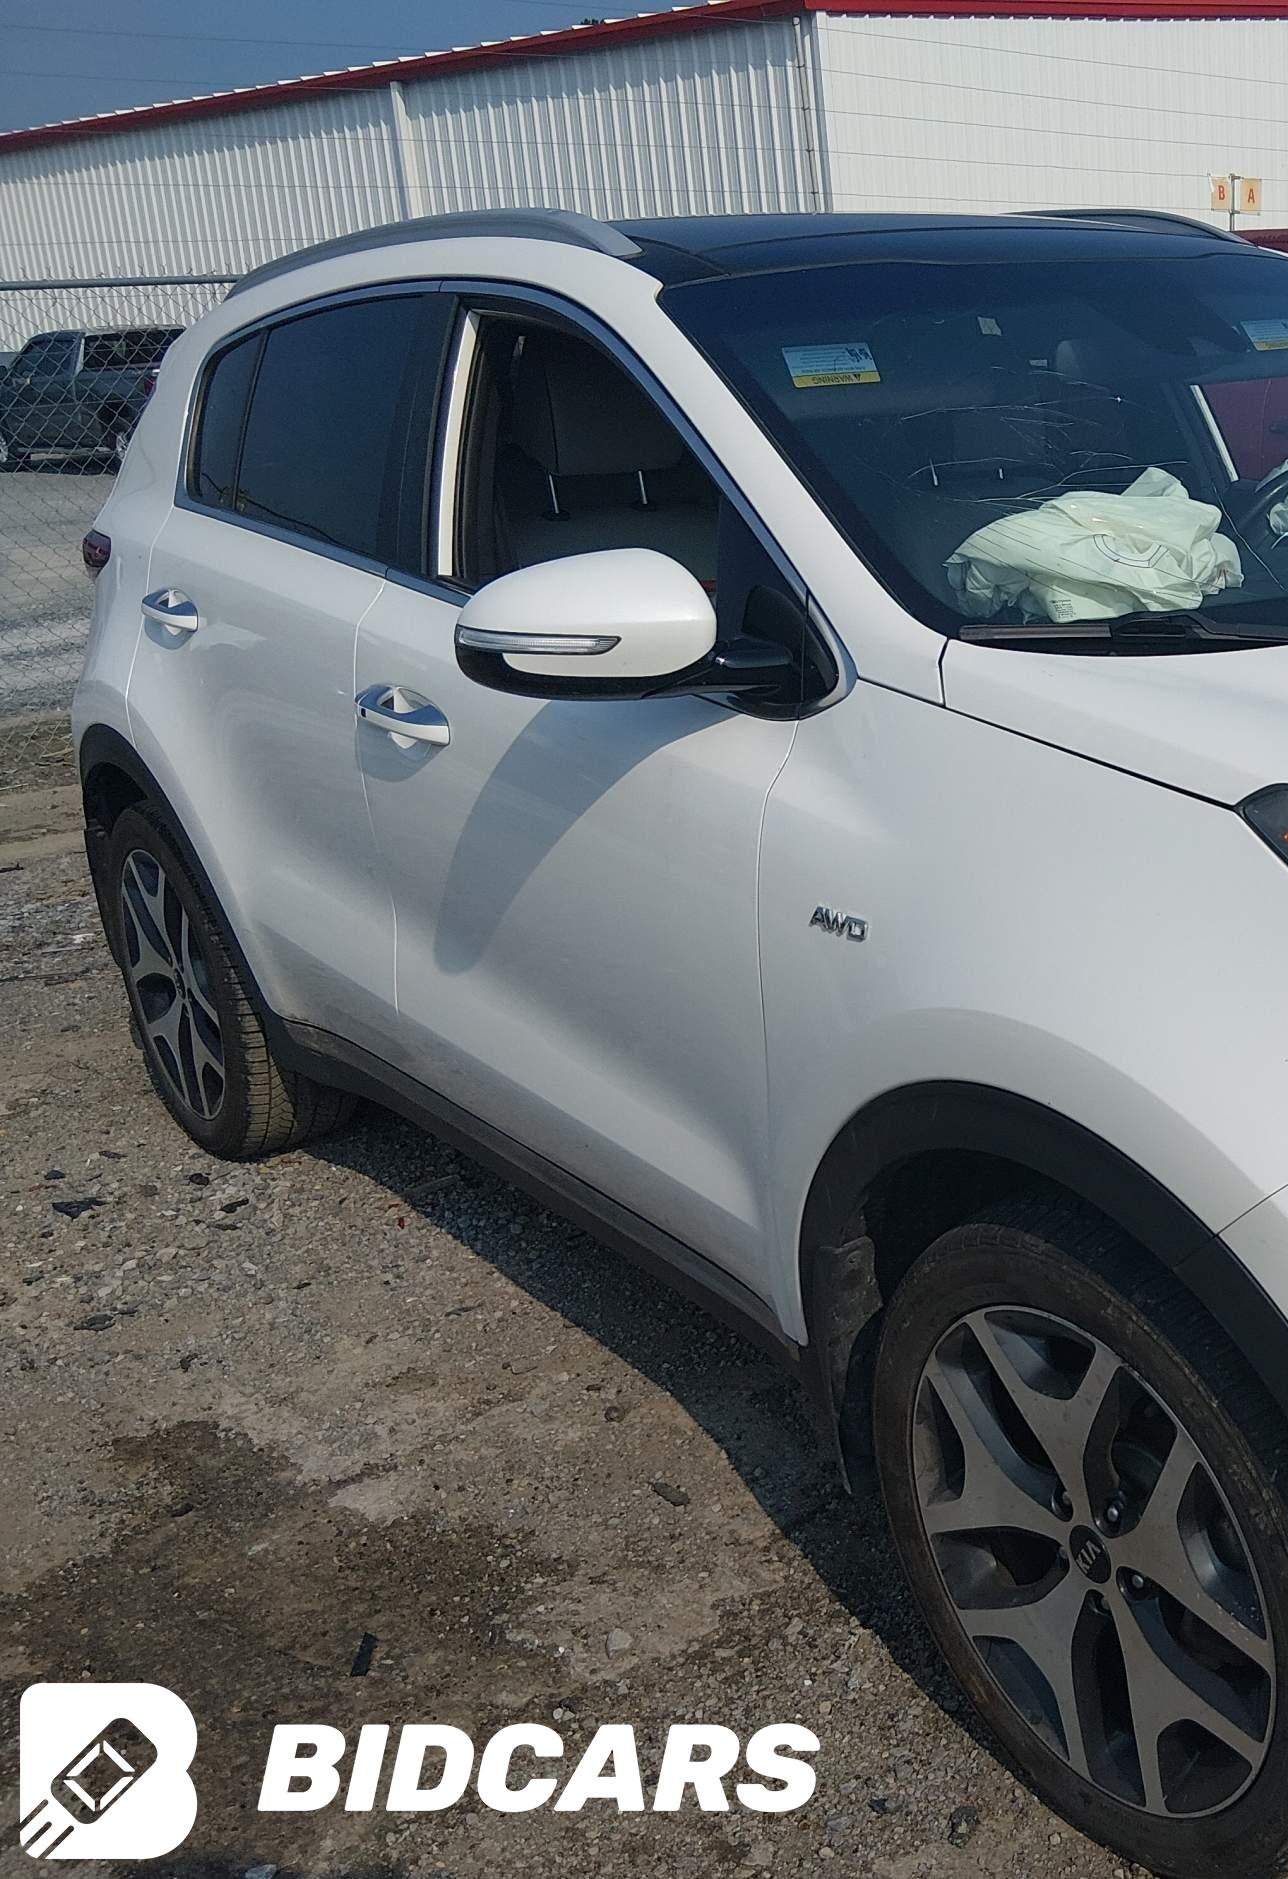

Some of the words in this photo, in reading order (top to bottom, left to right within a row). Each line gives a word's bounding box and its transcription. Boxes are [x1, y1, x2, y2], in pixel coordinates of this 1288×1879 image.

[1217, 184, 1226, 201] B
[1246, 187, 1256, 204] A
[811, 373, 854, 385] WARNING
[808, 906, 869, 943] AWD
[1076, 1540, 1101, 1574] KIA
